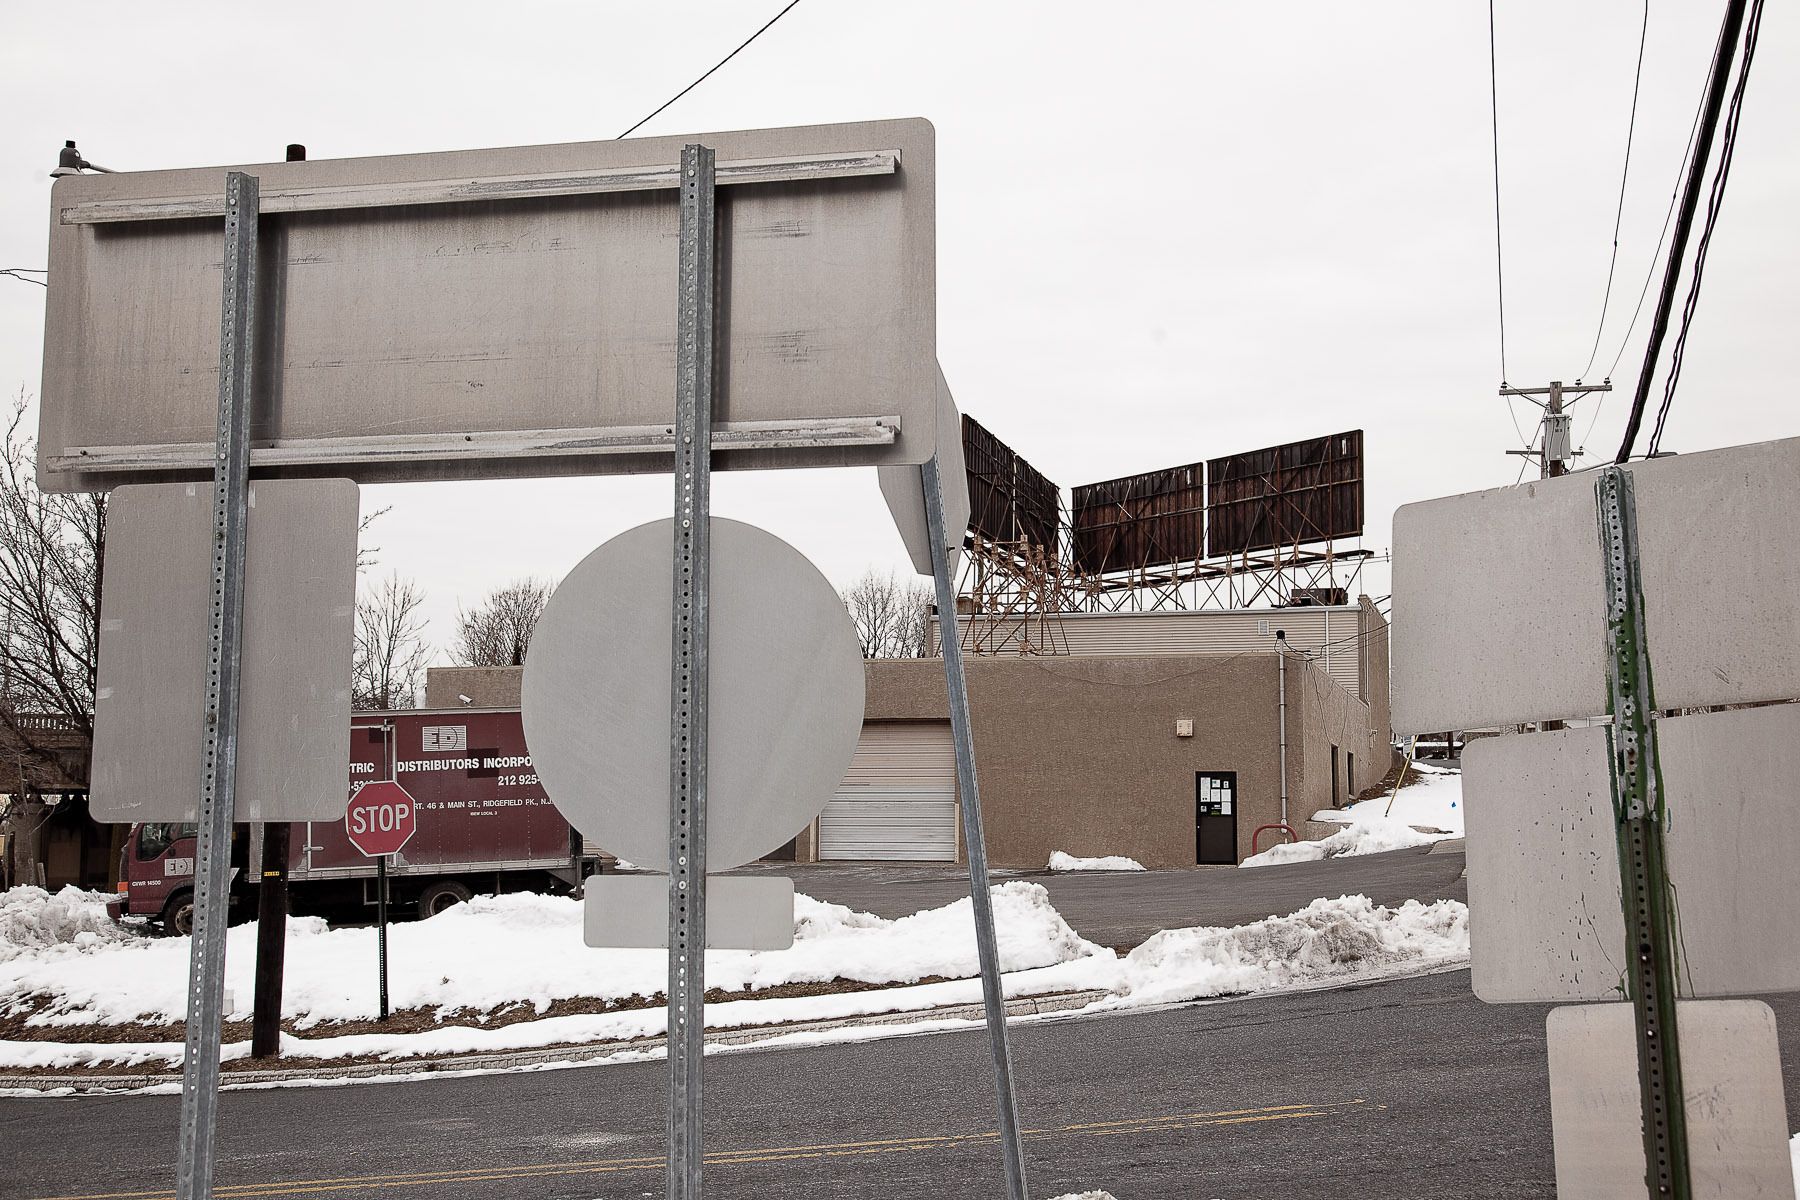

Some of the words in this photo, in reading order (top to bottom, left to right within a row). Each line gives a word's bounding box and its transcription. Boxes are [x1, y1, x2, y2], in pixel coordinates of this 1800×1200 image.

[349, 762, 375, 774] TRIC
[397, 758, 479, 772] DISTRIBUTORS
[483, 756, 532, 769] INCORPO
[498, 775, 516, 786] 212
[426, 802, 437, 810] 46
[447, 801, 465, 809] MAIN
[483, 799, 523, 807] RIDGEFIELD
[352, 803, 410, 834] STOP
